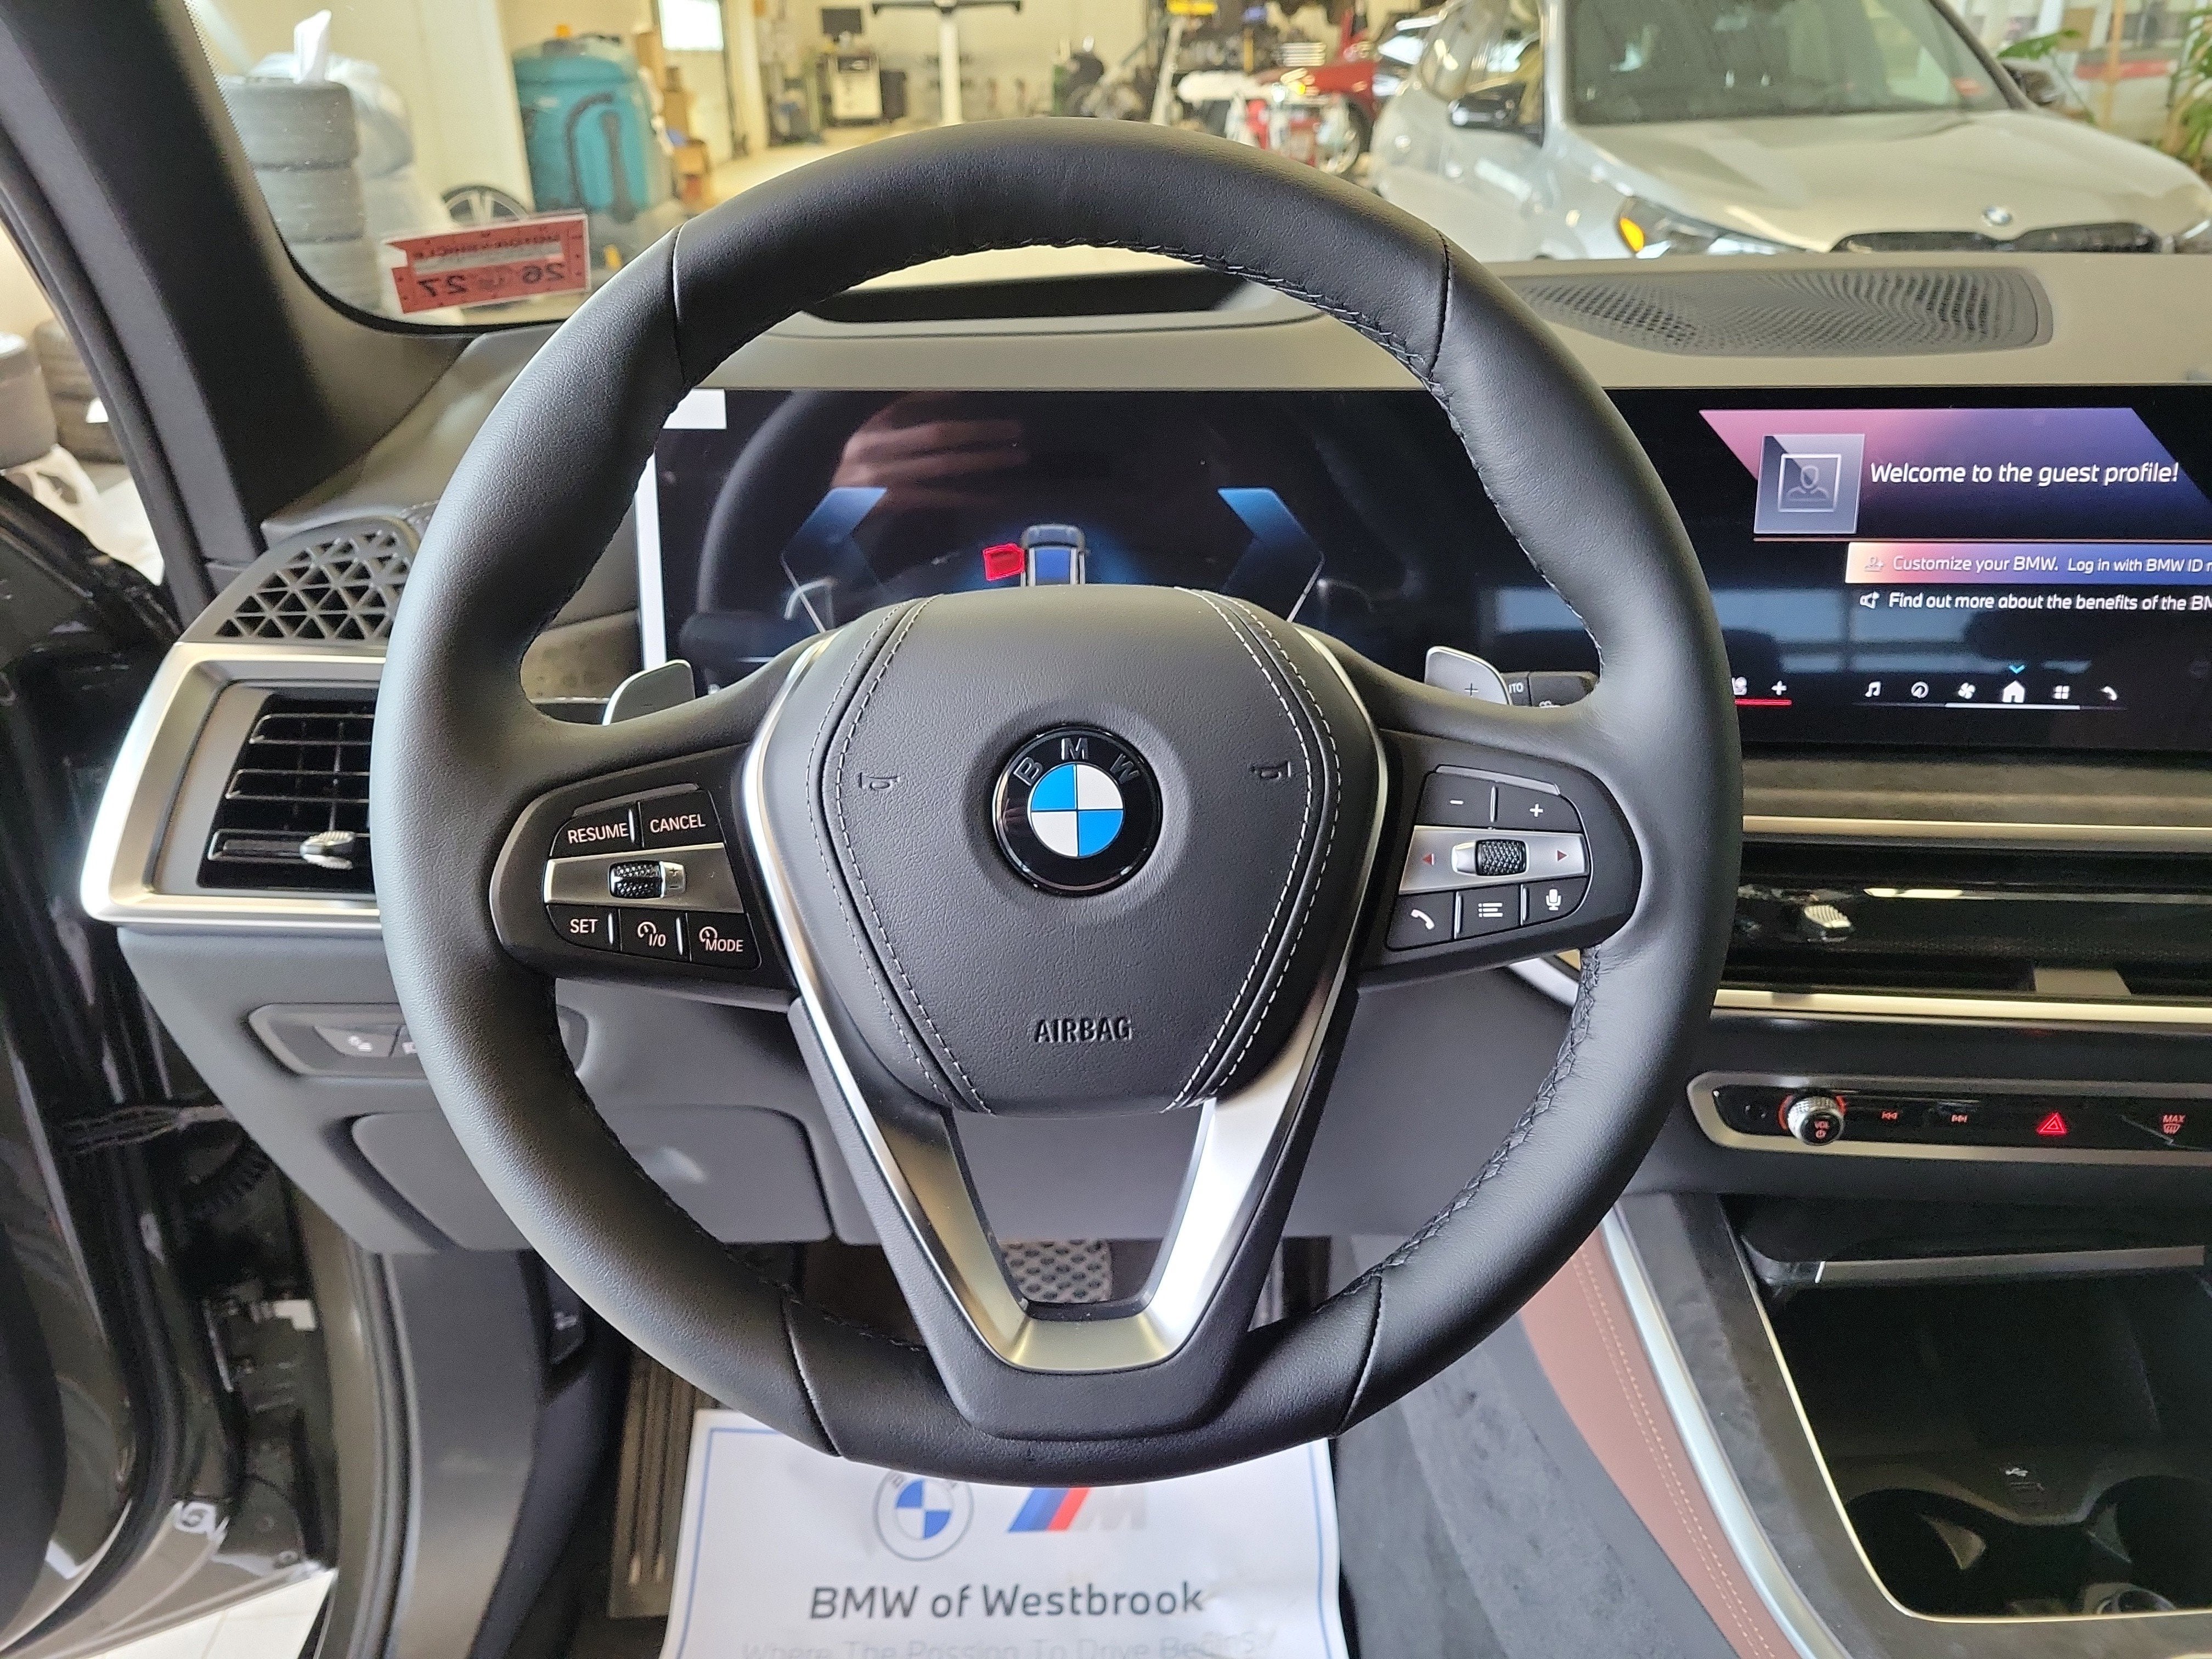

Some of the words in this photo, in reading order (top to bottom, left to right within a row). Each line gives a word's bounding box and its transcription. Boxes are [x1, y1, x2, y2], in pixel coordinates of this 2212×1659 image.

[1870, 462, 1966, 483] Welcome
[1973, 462, 1993, 483] to
[1998, 462, 2032, 483] the
[2038, 463, 2098, 487] guest
[2103, 462, 2180, 486] profile!
[1893, 555, 1972, 571] Customize
[1976, 558, 2011, 574] your
[2013, 556, 2058, 571] BMW.
[2067, 558, 2094, 574] Log
[2097, 558, 2110, 571] in
[2114, 558, 2142, 572] with
[2146, 558, 2185, 572] BMW
[2188, 558, 2203, 572] ID
[1889, 591, 1923, 608] Find
[1926, 594, 1953, 609] out
[1955, 596, 1995, 609] more
[1997, 593, 2044, 610] about
[2046, 594, 2073, 610] the
[2075, 594, 2138, 610] benefits
[2142, 595, 2159, 611] of
[2161, 595, 2187, 611] the
[1013, 737, 1140, 786] BMW
[567, 823, 629, 844] RESUME
[650, 814, 706, 833] CANCEL
[570, 918, 599, 934] SET
[705, 938, 744, 952] MODE
[1035, 1016, 1133, 1043] AIRBAG
[2163, 1114, 2186, 1123] MAX
[810, 1585, 920, 1619] BMW
[932, 1584, 972, 1618] of
[982, 1581, 1206, 1617] Westbrook
